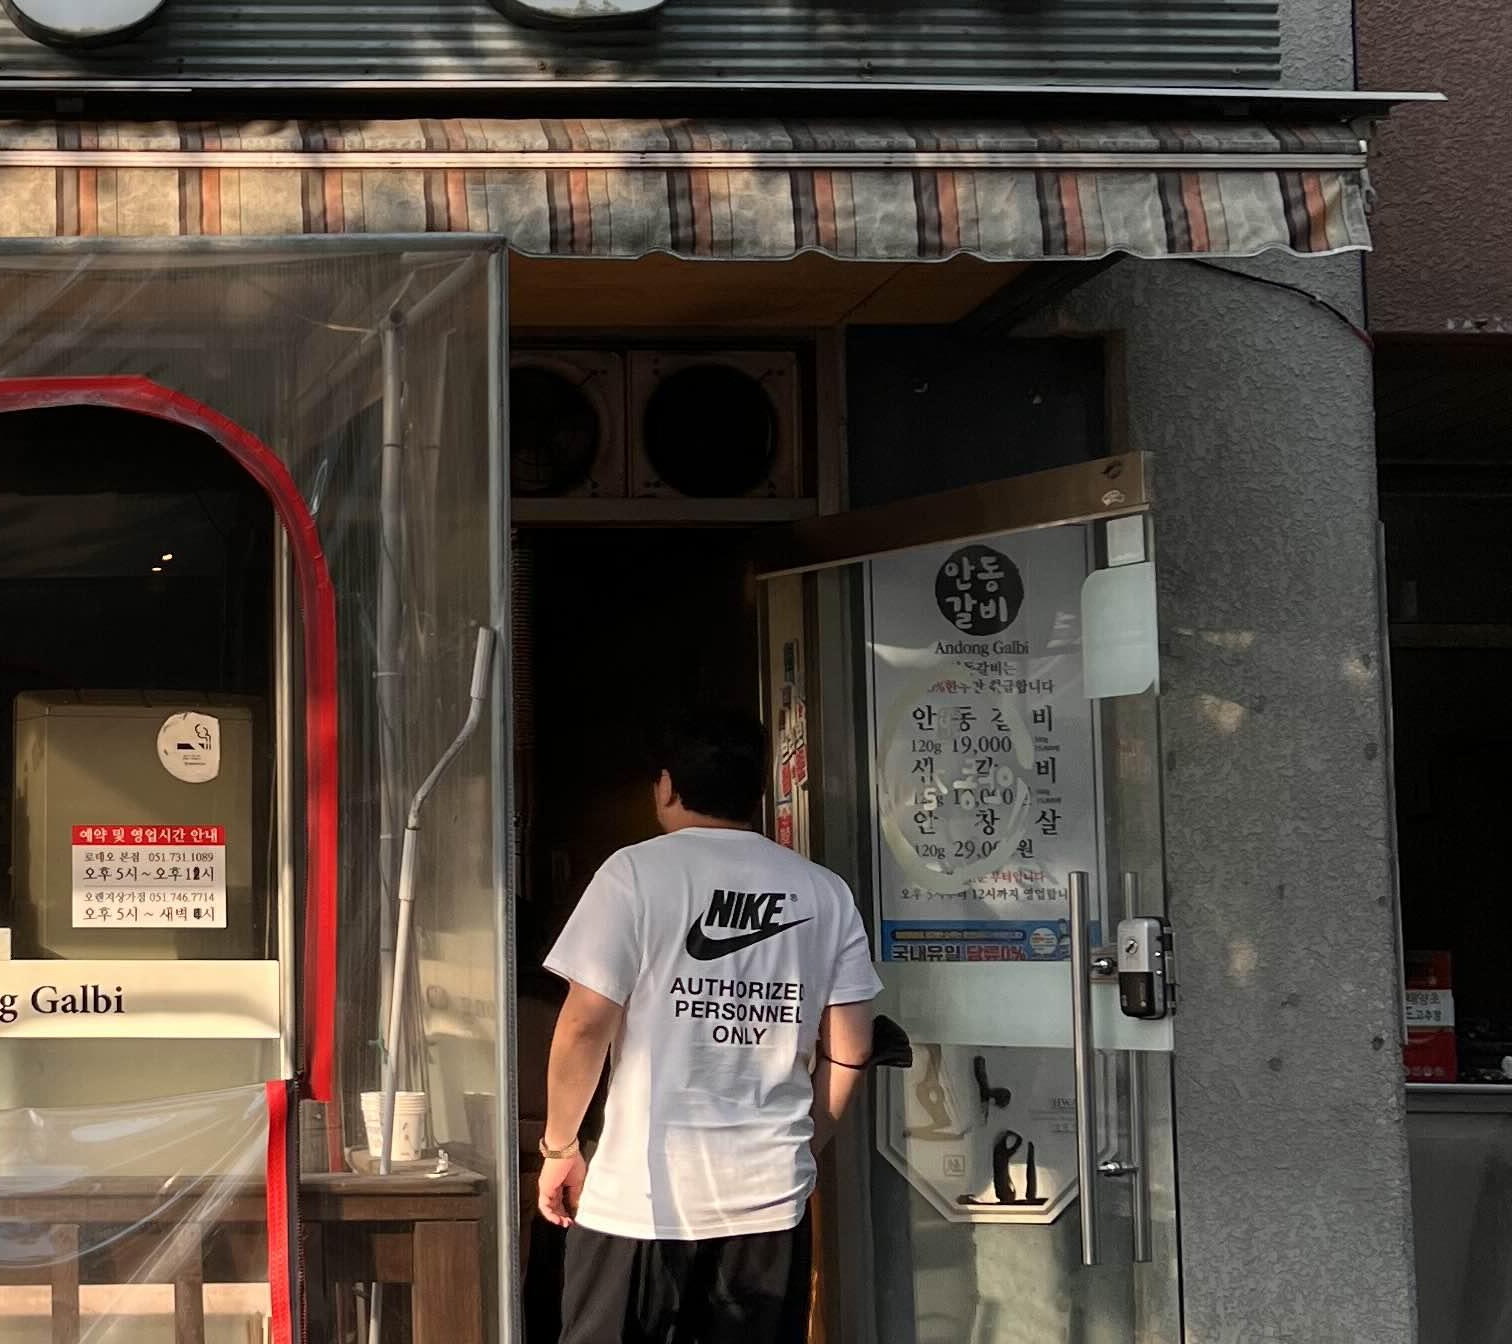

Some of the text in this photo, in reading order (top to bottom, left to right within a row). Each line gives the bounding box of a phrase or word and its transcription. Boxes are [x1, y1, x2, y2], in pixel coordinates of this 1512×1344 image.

[945, 557, 1004, 591] 안동
[945, 593, 1008, 630] 갈비
[935, 640, 1029, 657] Andong Galbi
[912, 739, 942, 755] 120g
[80, 827, 218, 843] 예약 및 영업시간 안내
[83, 867, 112, 882] 오후
[116, 866, 137, 881] 5시
[153, 866, 182, 881] 오후
[83, 907, 112, 922] 오후
[117, 906, 138, 922] 5시
[159, 906, 187, 922] 새벽
[704, 889, 786, 931] NIKE
[31, 984, 125, 1014] Galbi
[675, 999, 803, 1024] PERSONNEL
[712, 1025, 767, 1045] ONLY
